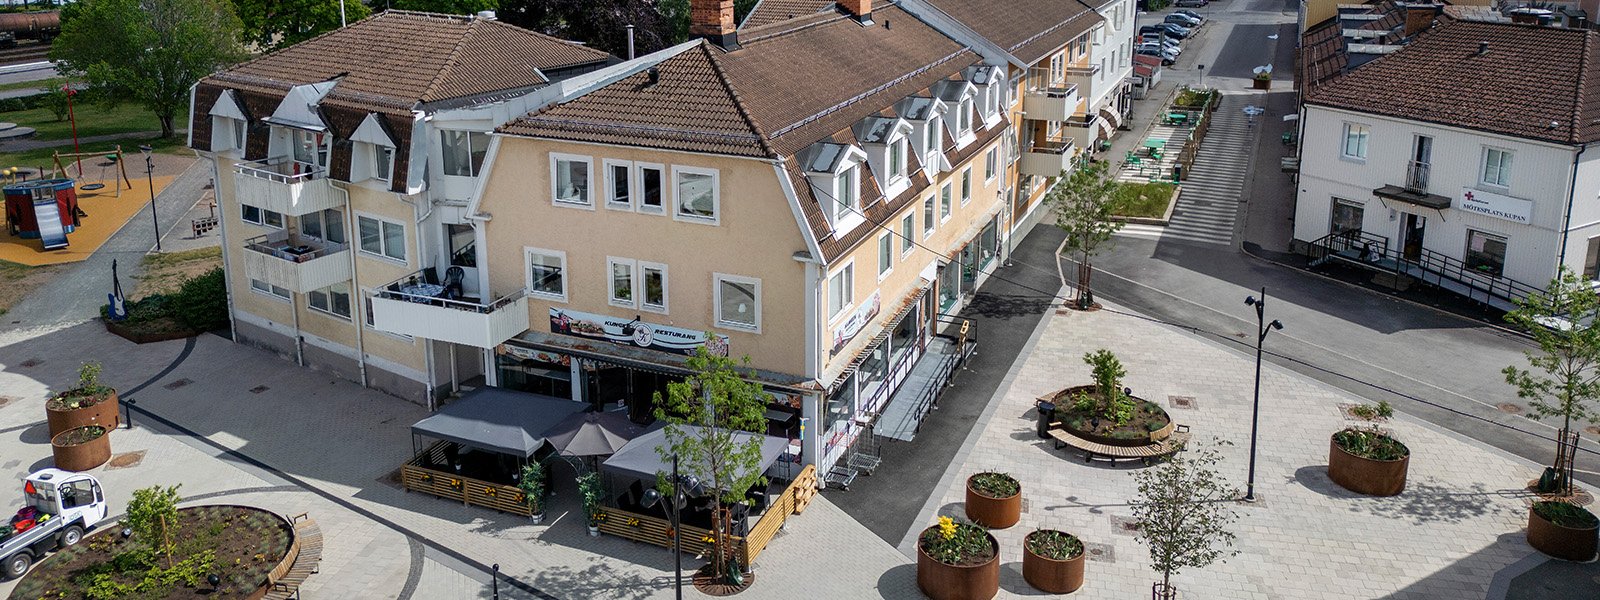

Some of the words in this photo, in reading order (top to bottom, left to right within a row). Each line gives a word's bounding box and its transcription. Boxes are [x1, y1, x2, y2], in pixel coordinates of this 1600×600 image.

[1463, 203, 1503, 216] MÖTESPLATS
[1504, 212, 1526, 221] KUPAN
[654, 329, 696, 340] RESTURANG
